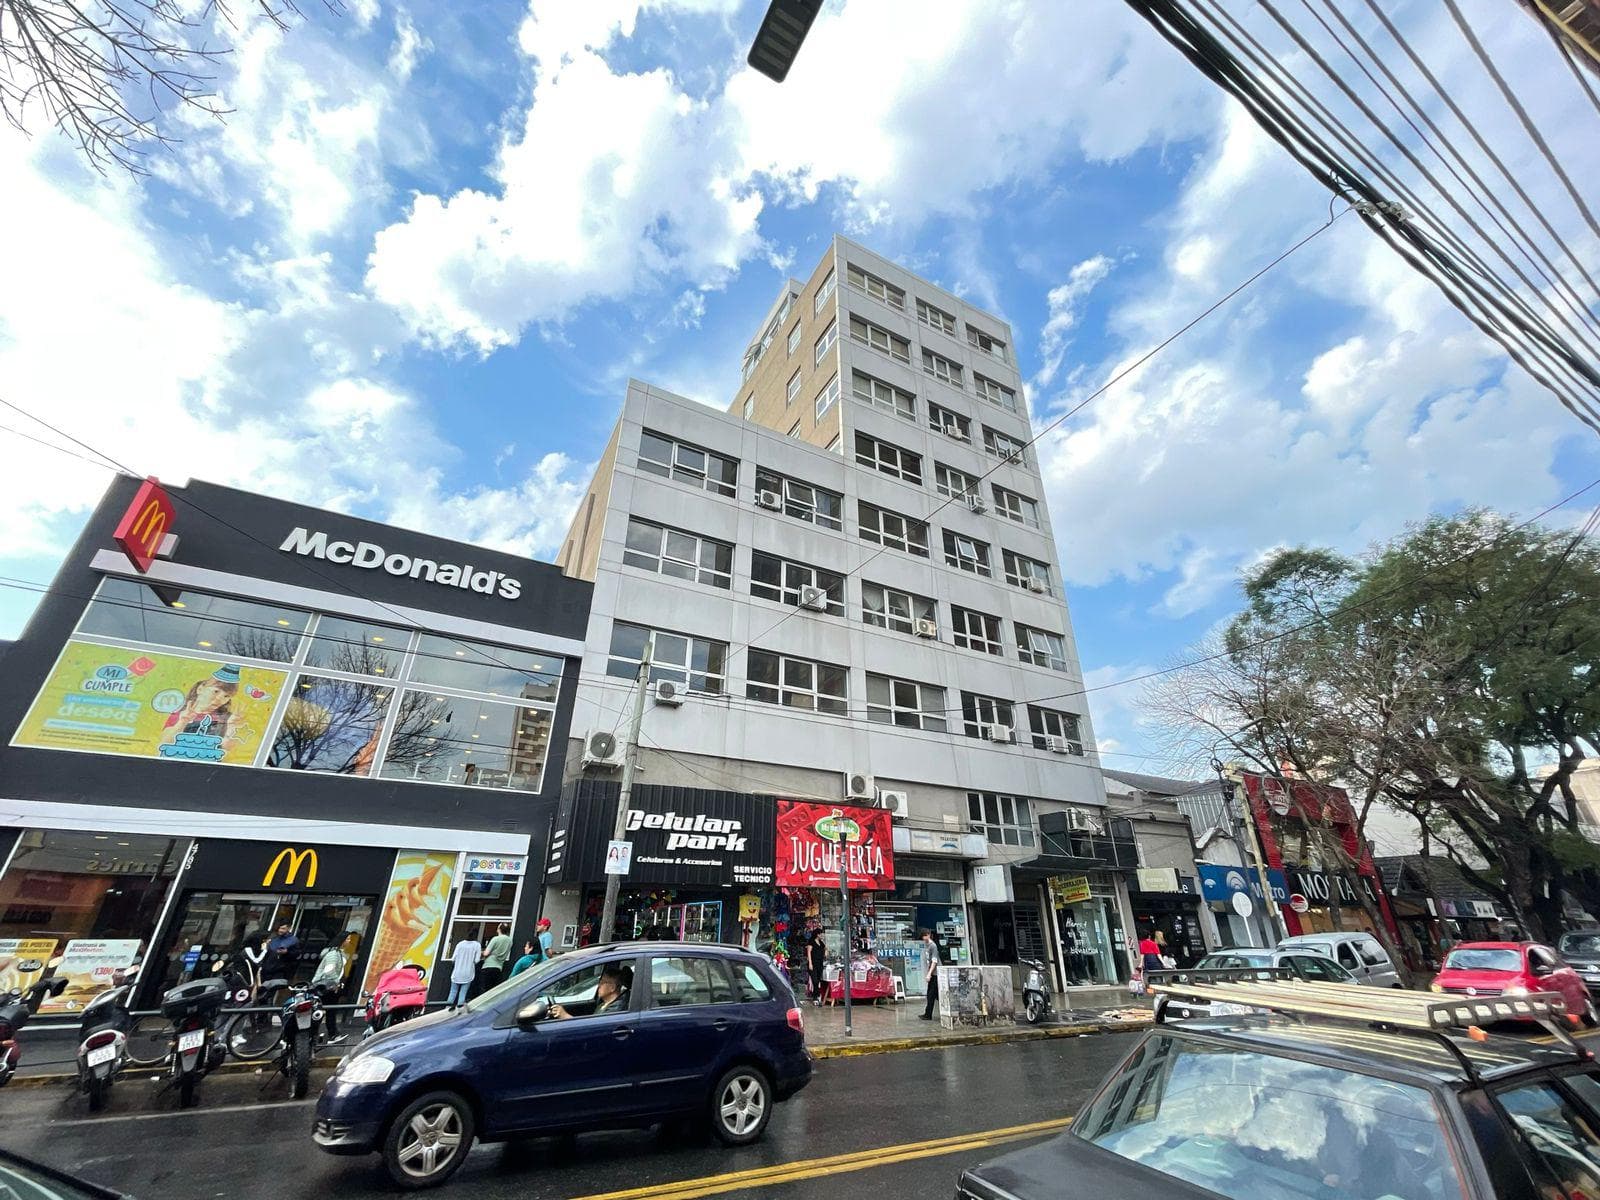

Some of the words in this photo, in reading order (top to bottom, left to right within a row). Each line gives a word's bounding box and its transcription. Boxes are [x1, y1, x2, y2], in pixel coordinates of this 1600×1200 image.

[278, 526, 522, 600] McDonald's
[103, 666, 121, 679] MI
[84, 679, 133, 693] CUMPLE
[57, 703, 139, 723] deseos
[625, 809, 743, 833] Celular
[666, 833, 748, 852] park
[469, 857, 521, 871] postres
[674, 857, 682, 865] &
[790, 836, 885, 876] JUGUEERÍA
[733, 865, 773, 875] SERVICIO
[734, 874, 771, 884] TECNICO
[1251, 880, 1286, 900] Mtro
[1297, 873, 1377, 901] MOTAA
